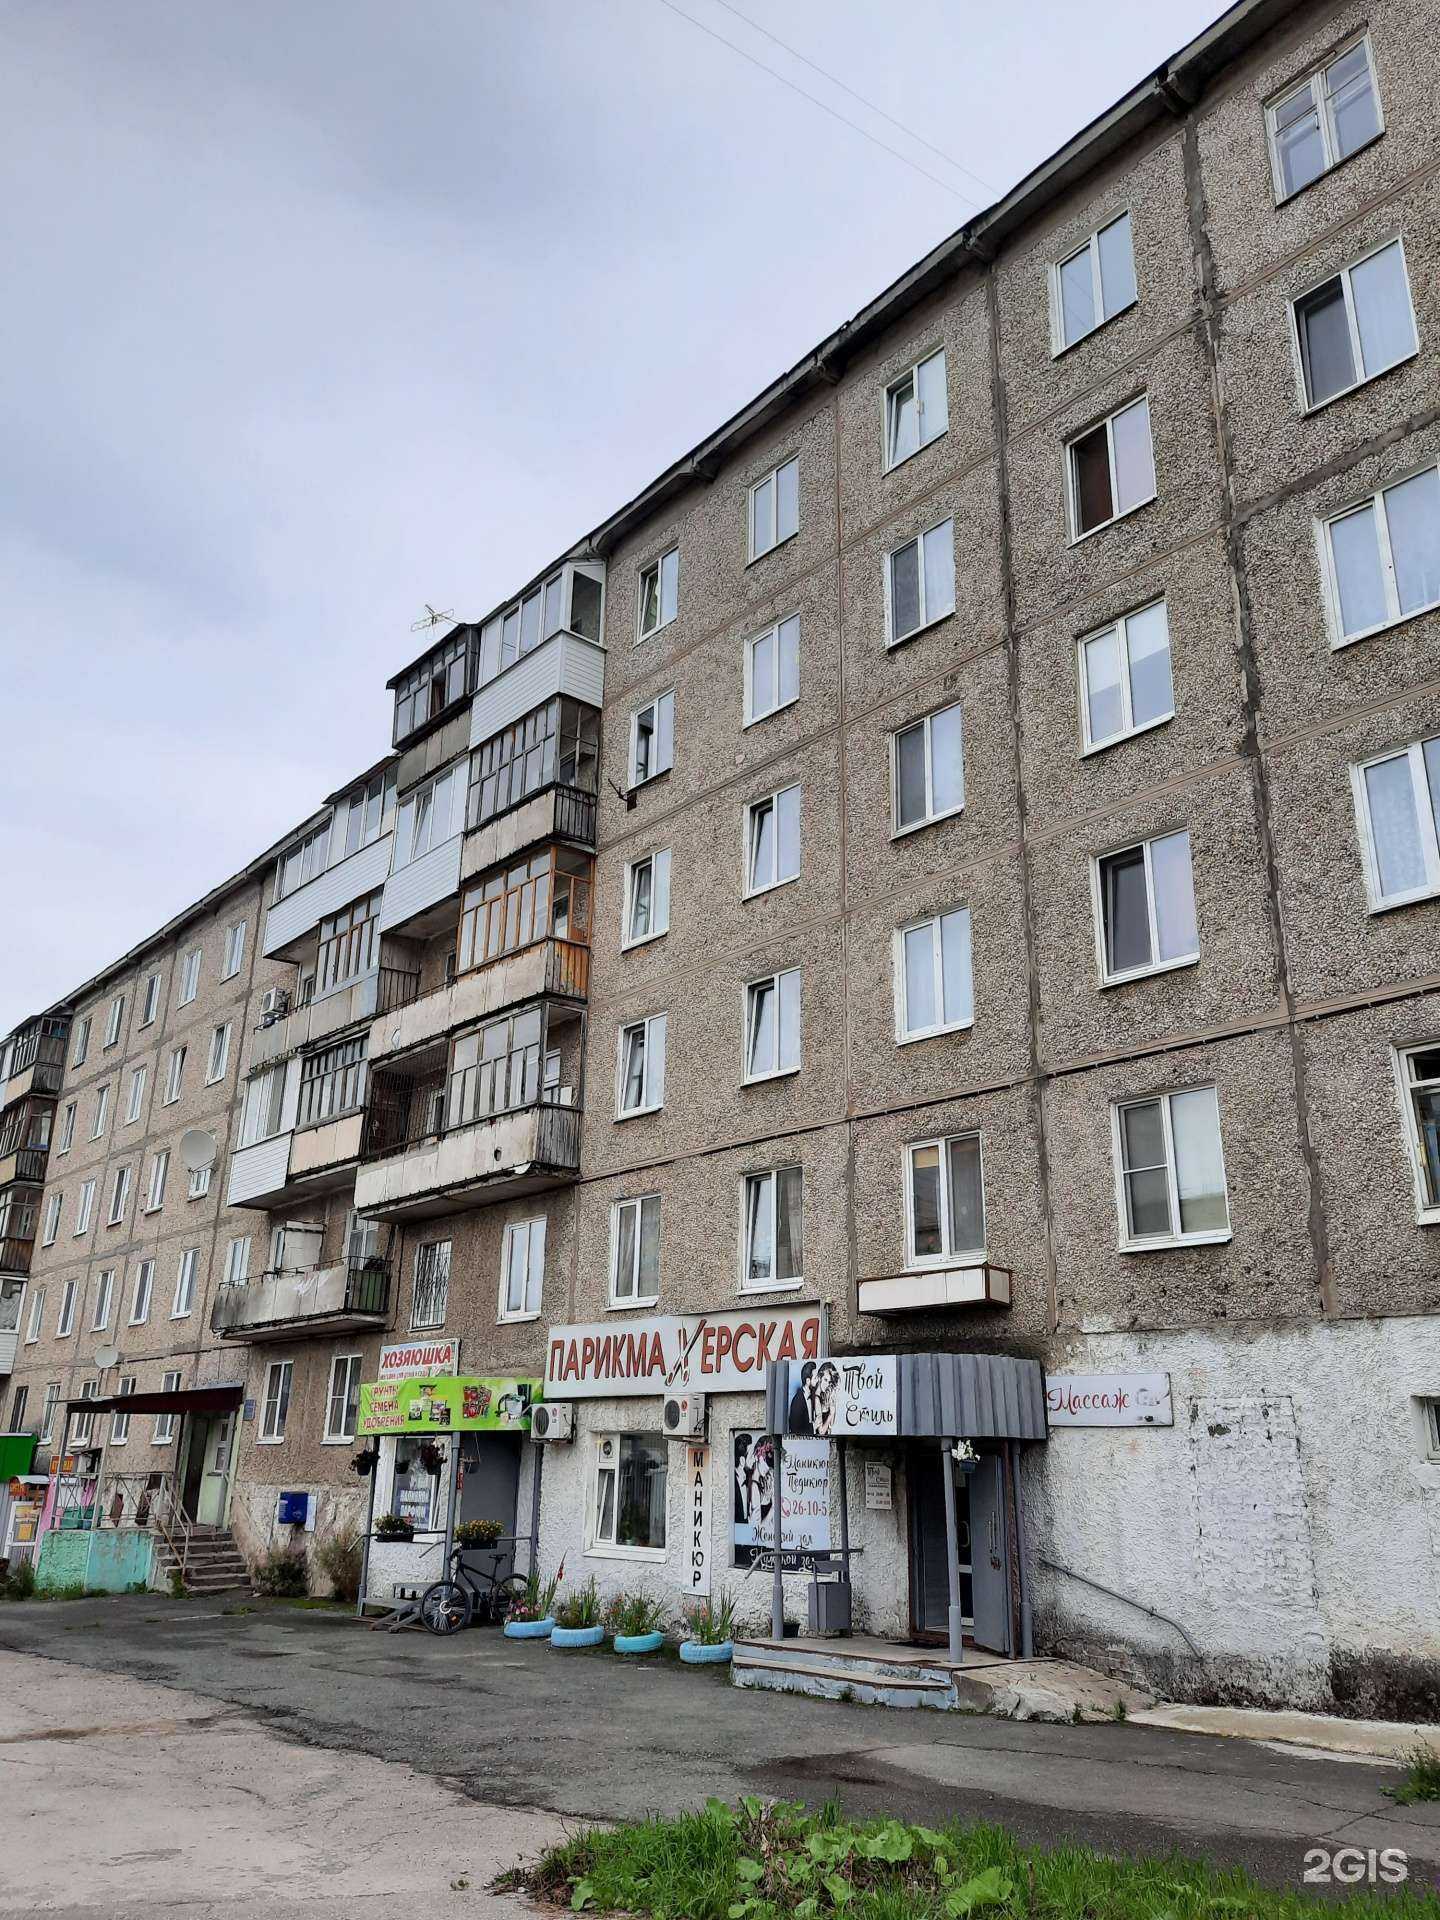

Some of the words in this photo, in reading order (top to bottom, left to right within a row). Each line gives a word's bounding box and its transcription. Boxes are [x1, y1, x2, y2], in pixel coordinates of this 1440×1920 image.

[382, 1345, 452, 1369] ХОЗЯЮШКА
[843, 1363, 883, 1400] Твой
[370, 1400, 399, 1413] СЕМЕНА
[1047, 1384, 1130, 1415] Массаж
[363, 1414, 405, 1430] УДОБРЕНИЯ
[846, 1401, 893, 1426] Стиль
[786, 1471, 829, 1496] Педикюр
[691, 1451, 705, 1587] МАНИКЮР
